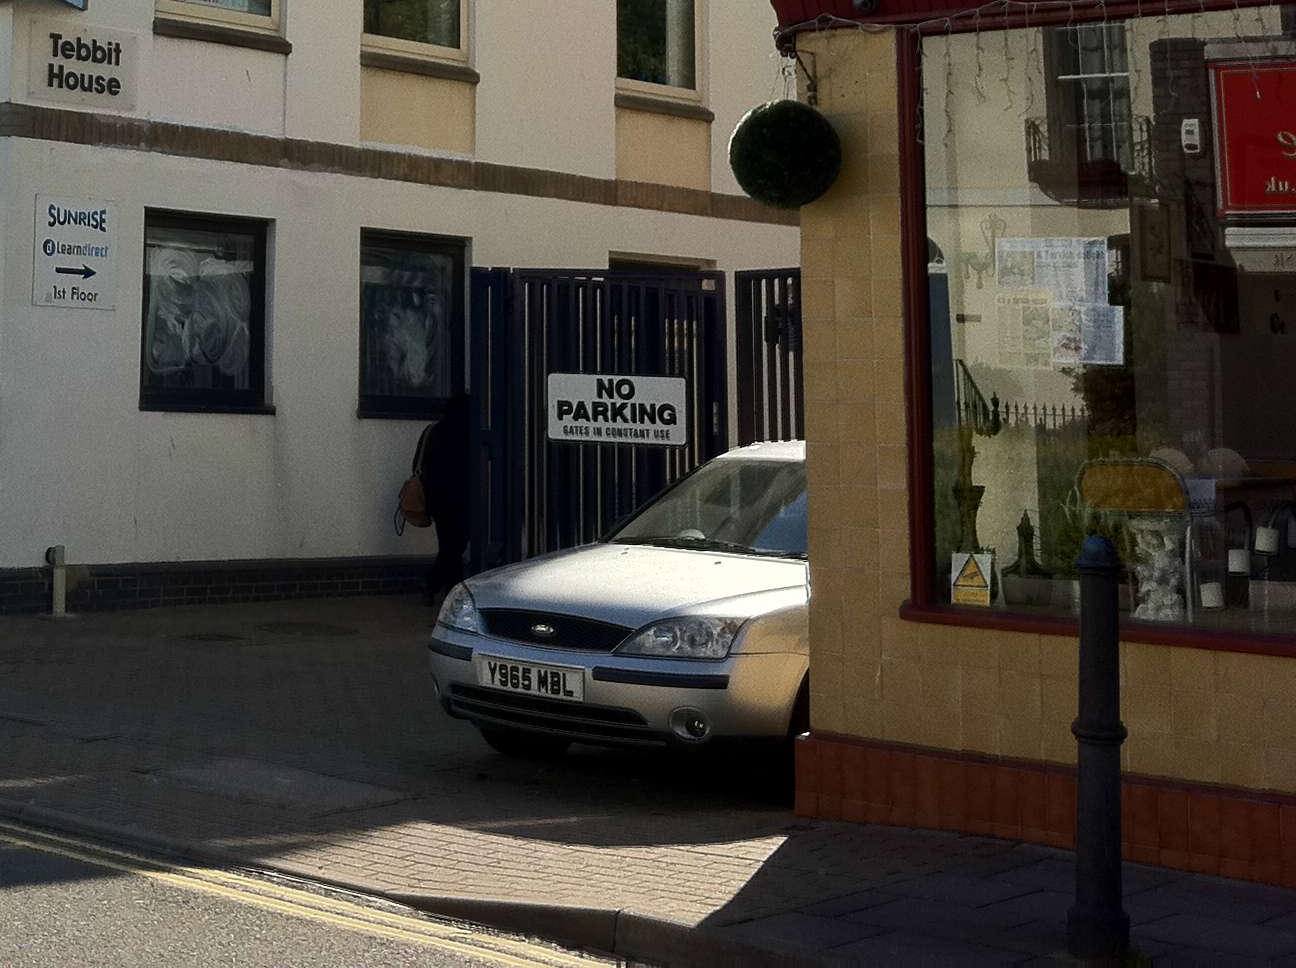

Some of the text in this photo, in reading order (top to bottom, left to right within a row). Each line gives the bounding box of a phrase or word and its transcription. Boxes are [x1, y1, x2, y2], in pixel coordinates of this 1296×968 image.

[49, 33, 122, 66] Tebbit
[47, 63, 122, 96] House
[47, 203, 107, 232] SUNRISE
[53, 285, 99, 302] 1st Floor
[596, 378, 635, 400] NO
[557, 400, 677, 426] PARKING
[563, 425, 671, 441] GATES IN CONSTANT USE
[487, 661, 574, 697] Y965 MBL
